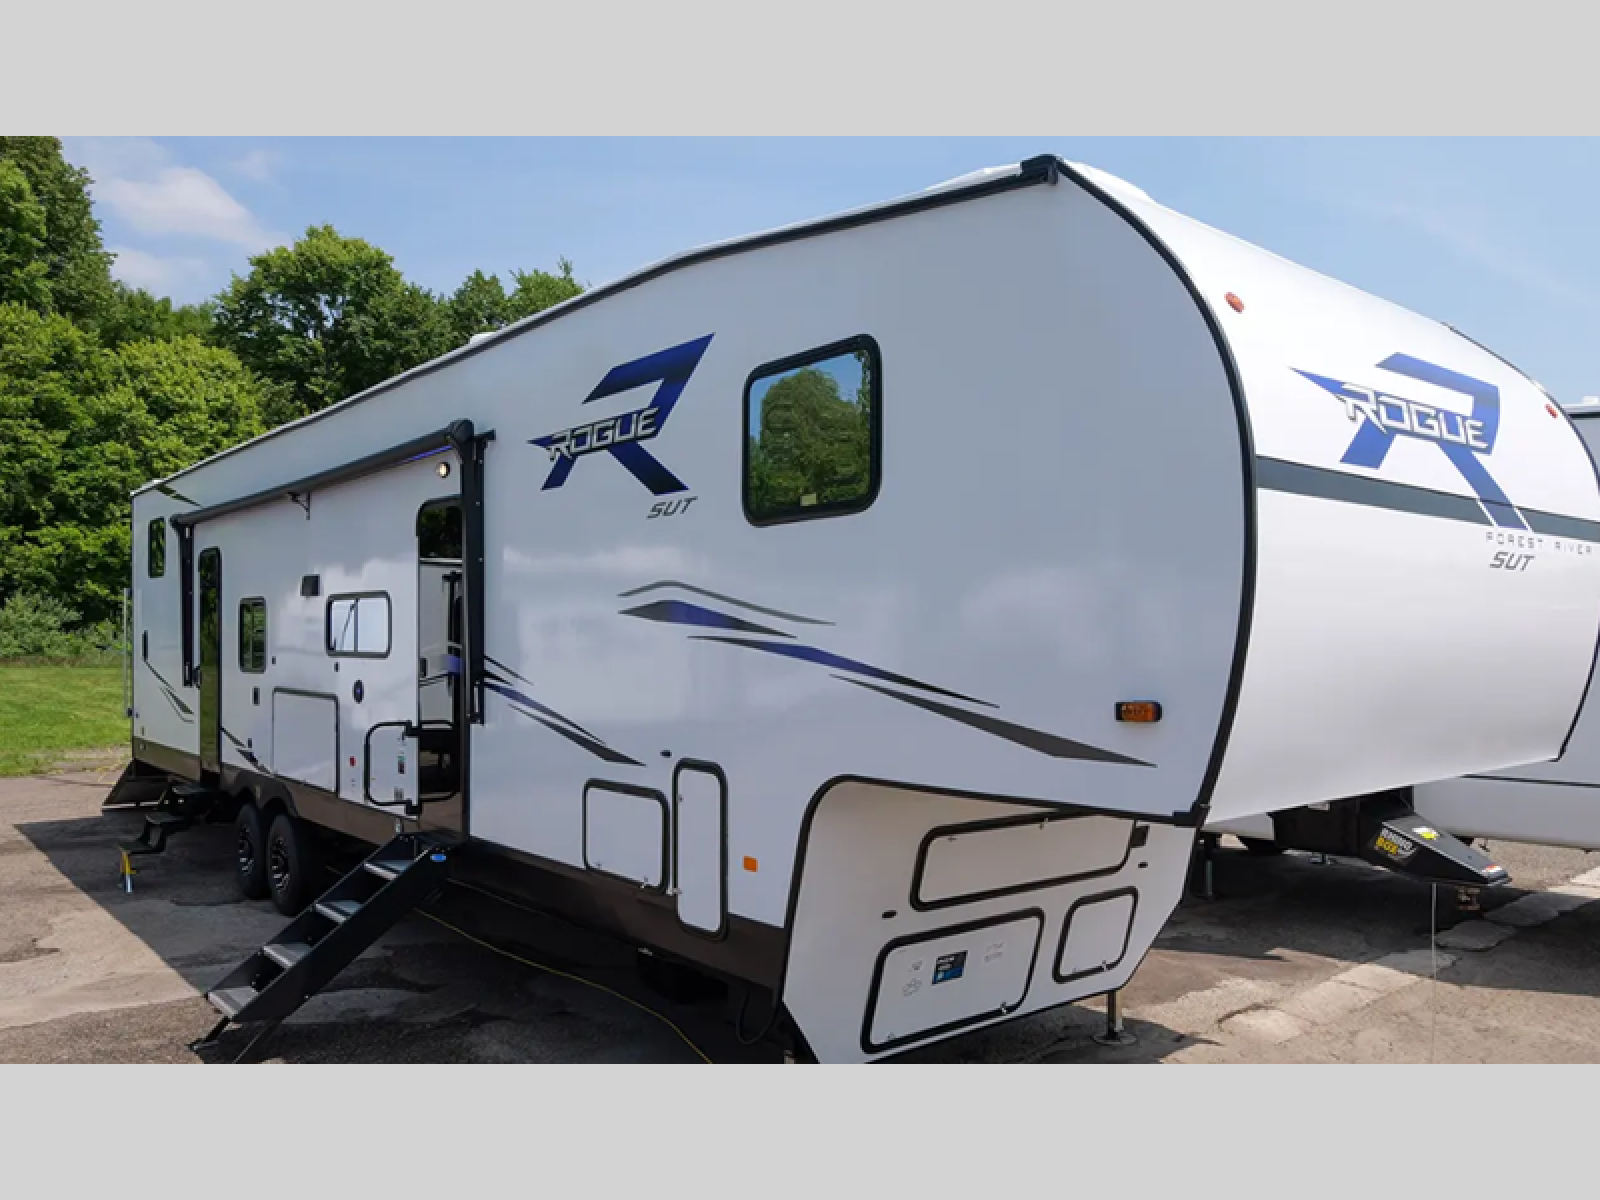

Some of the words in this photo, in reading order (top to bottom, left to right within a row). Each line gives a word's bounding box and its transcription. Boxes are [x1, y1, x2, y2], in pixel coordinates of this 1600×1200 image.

[1335, 381, 1490, 449] ROGUE
[545, 406, 661, 462] ROGUE
[646, 496, 698, 519] SUT
[1485, 531, 1545, 549] FOREST
[1489, 551, 1536, 572] SUT
